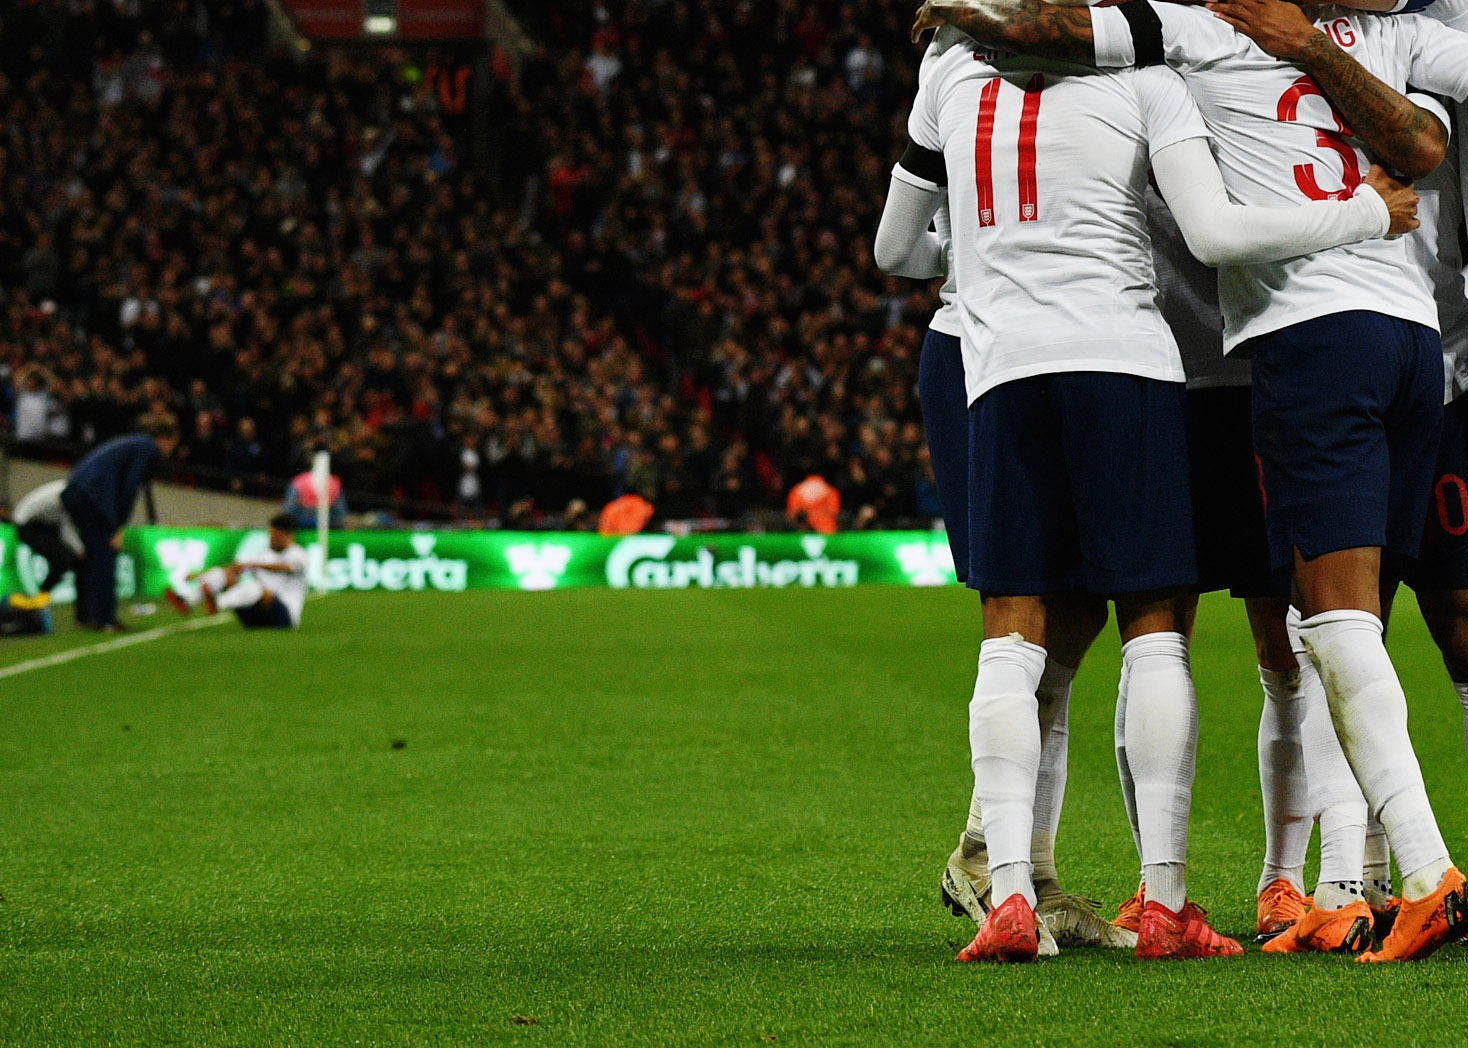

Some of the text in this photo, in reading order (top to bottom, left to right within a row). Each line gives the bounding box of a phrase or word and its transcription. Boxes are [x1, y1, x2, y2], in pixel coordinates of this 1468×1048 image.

[974, 73, 1044, 227] 11
[1276, 74, 1362, 201] 3
[605, 526, 859, 588] Carlsberg
